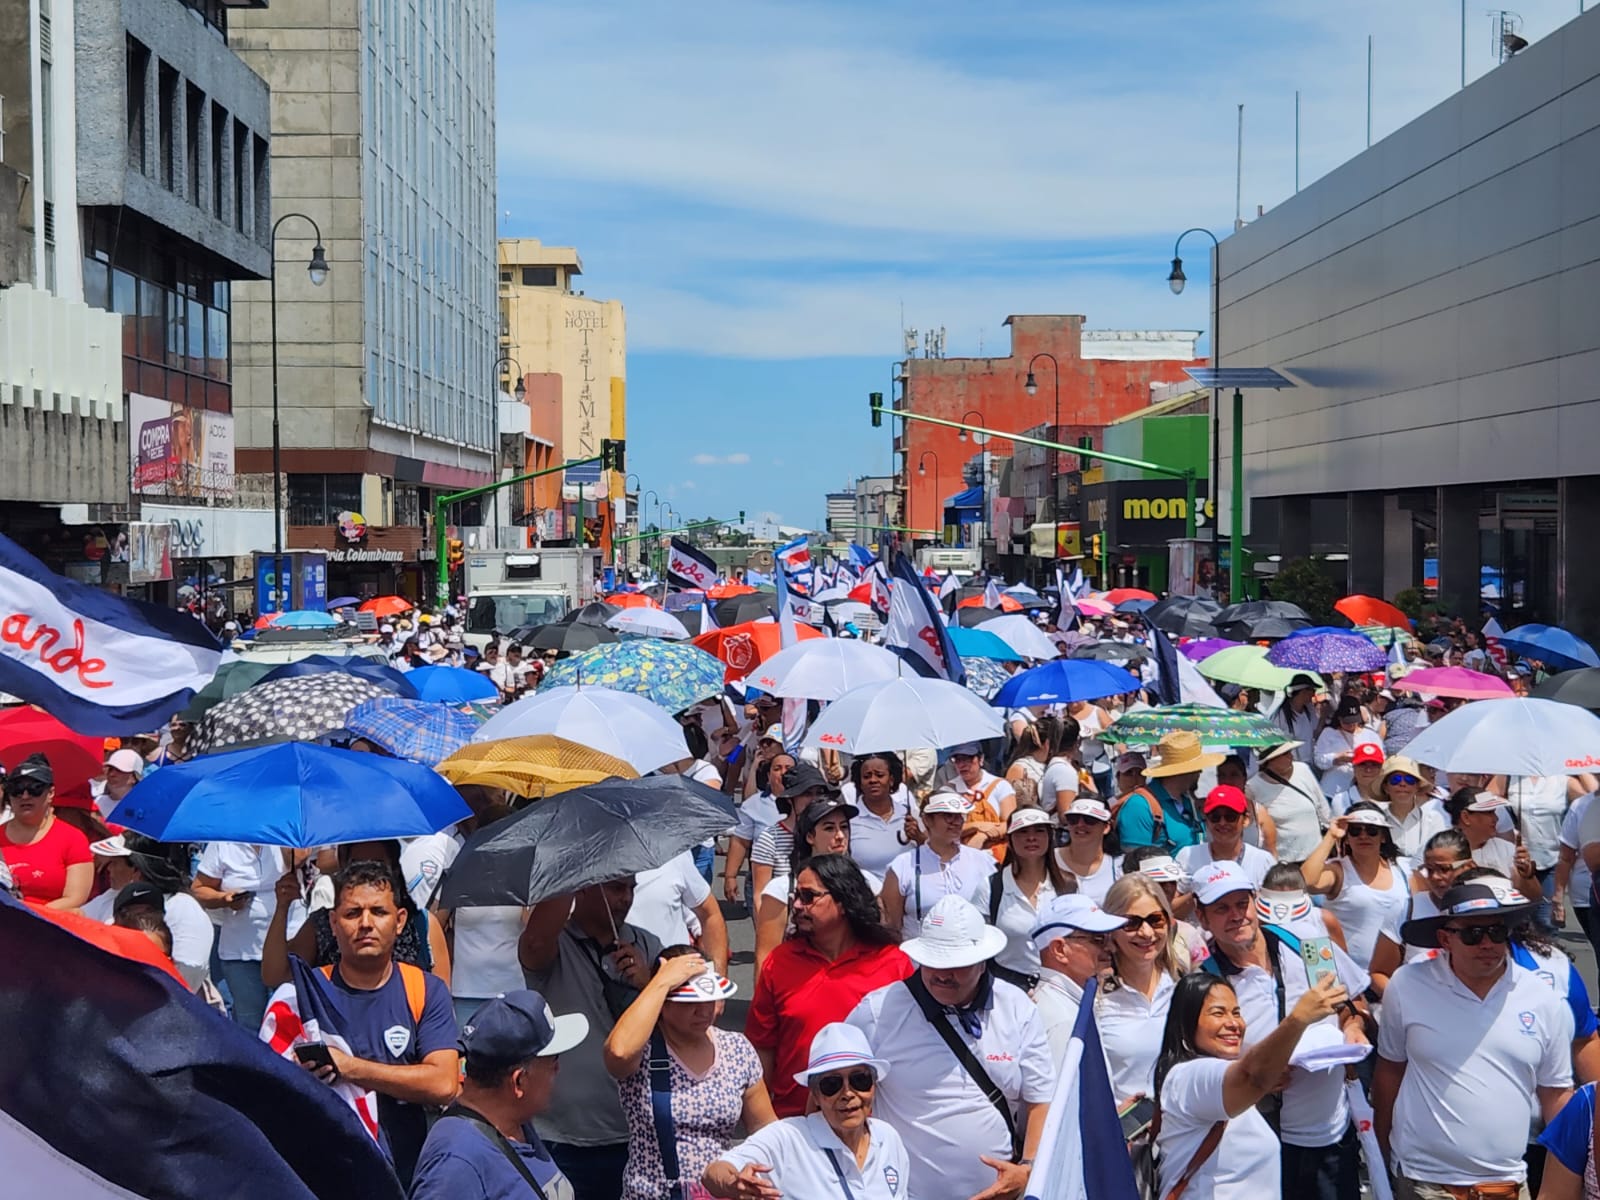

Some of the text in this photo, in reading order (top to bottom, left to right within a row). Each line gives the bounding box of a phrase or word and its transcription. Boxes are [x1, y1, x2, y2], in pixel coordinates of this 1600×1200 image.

[565, 310, 596, 318] NUEVO
[565, 318, 609, 329] HOTEL
[142, 424, 171, 451] COMPRA
[347, 548, 404, 562] Colombiana
[1, 614, 114, 688] ande
